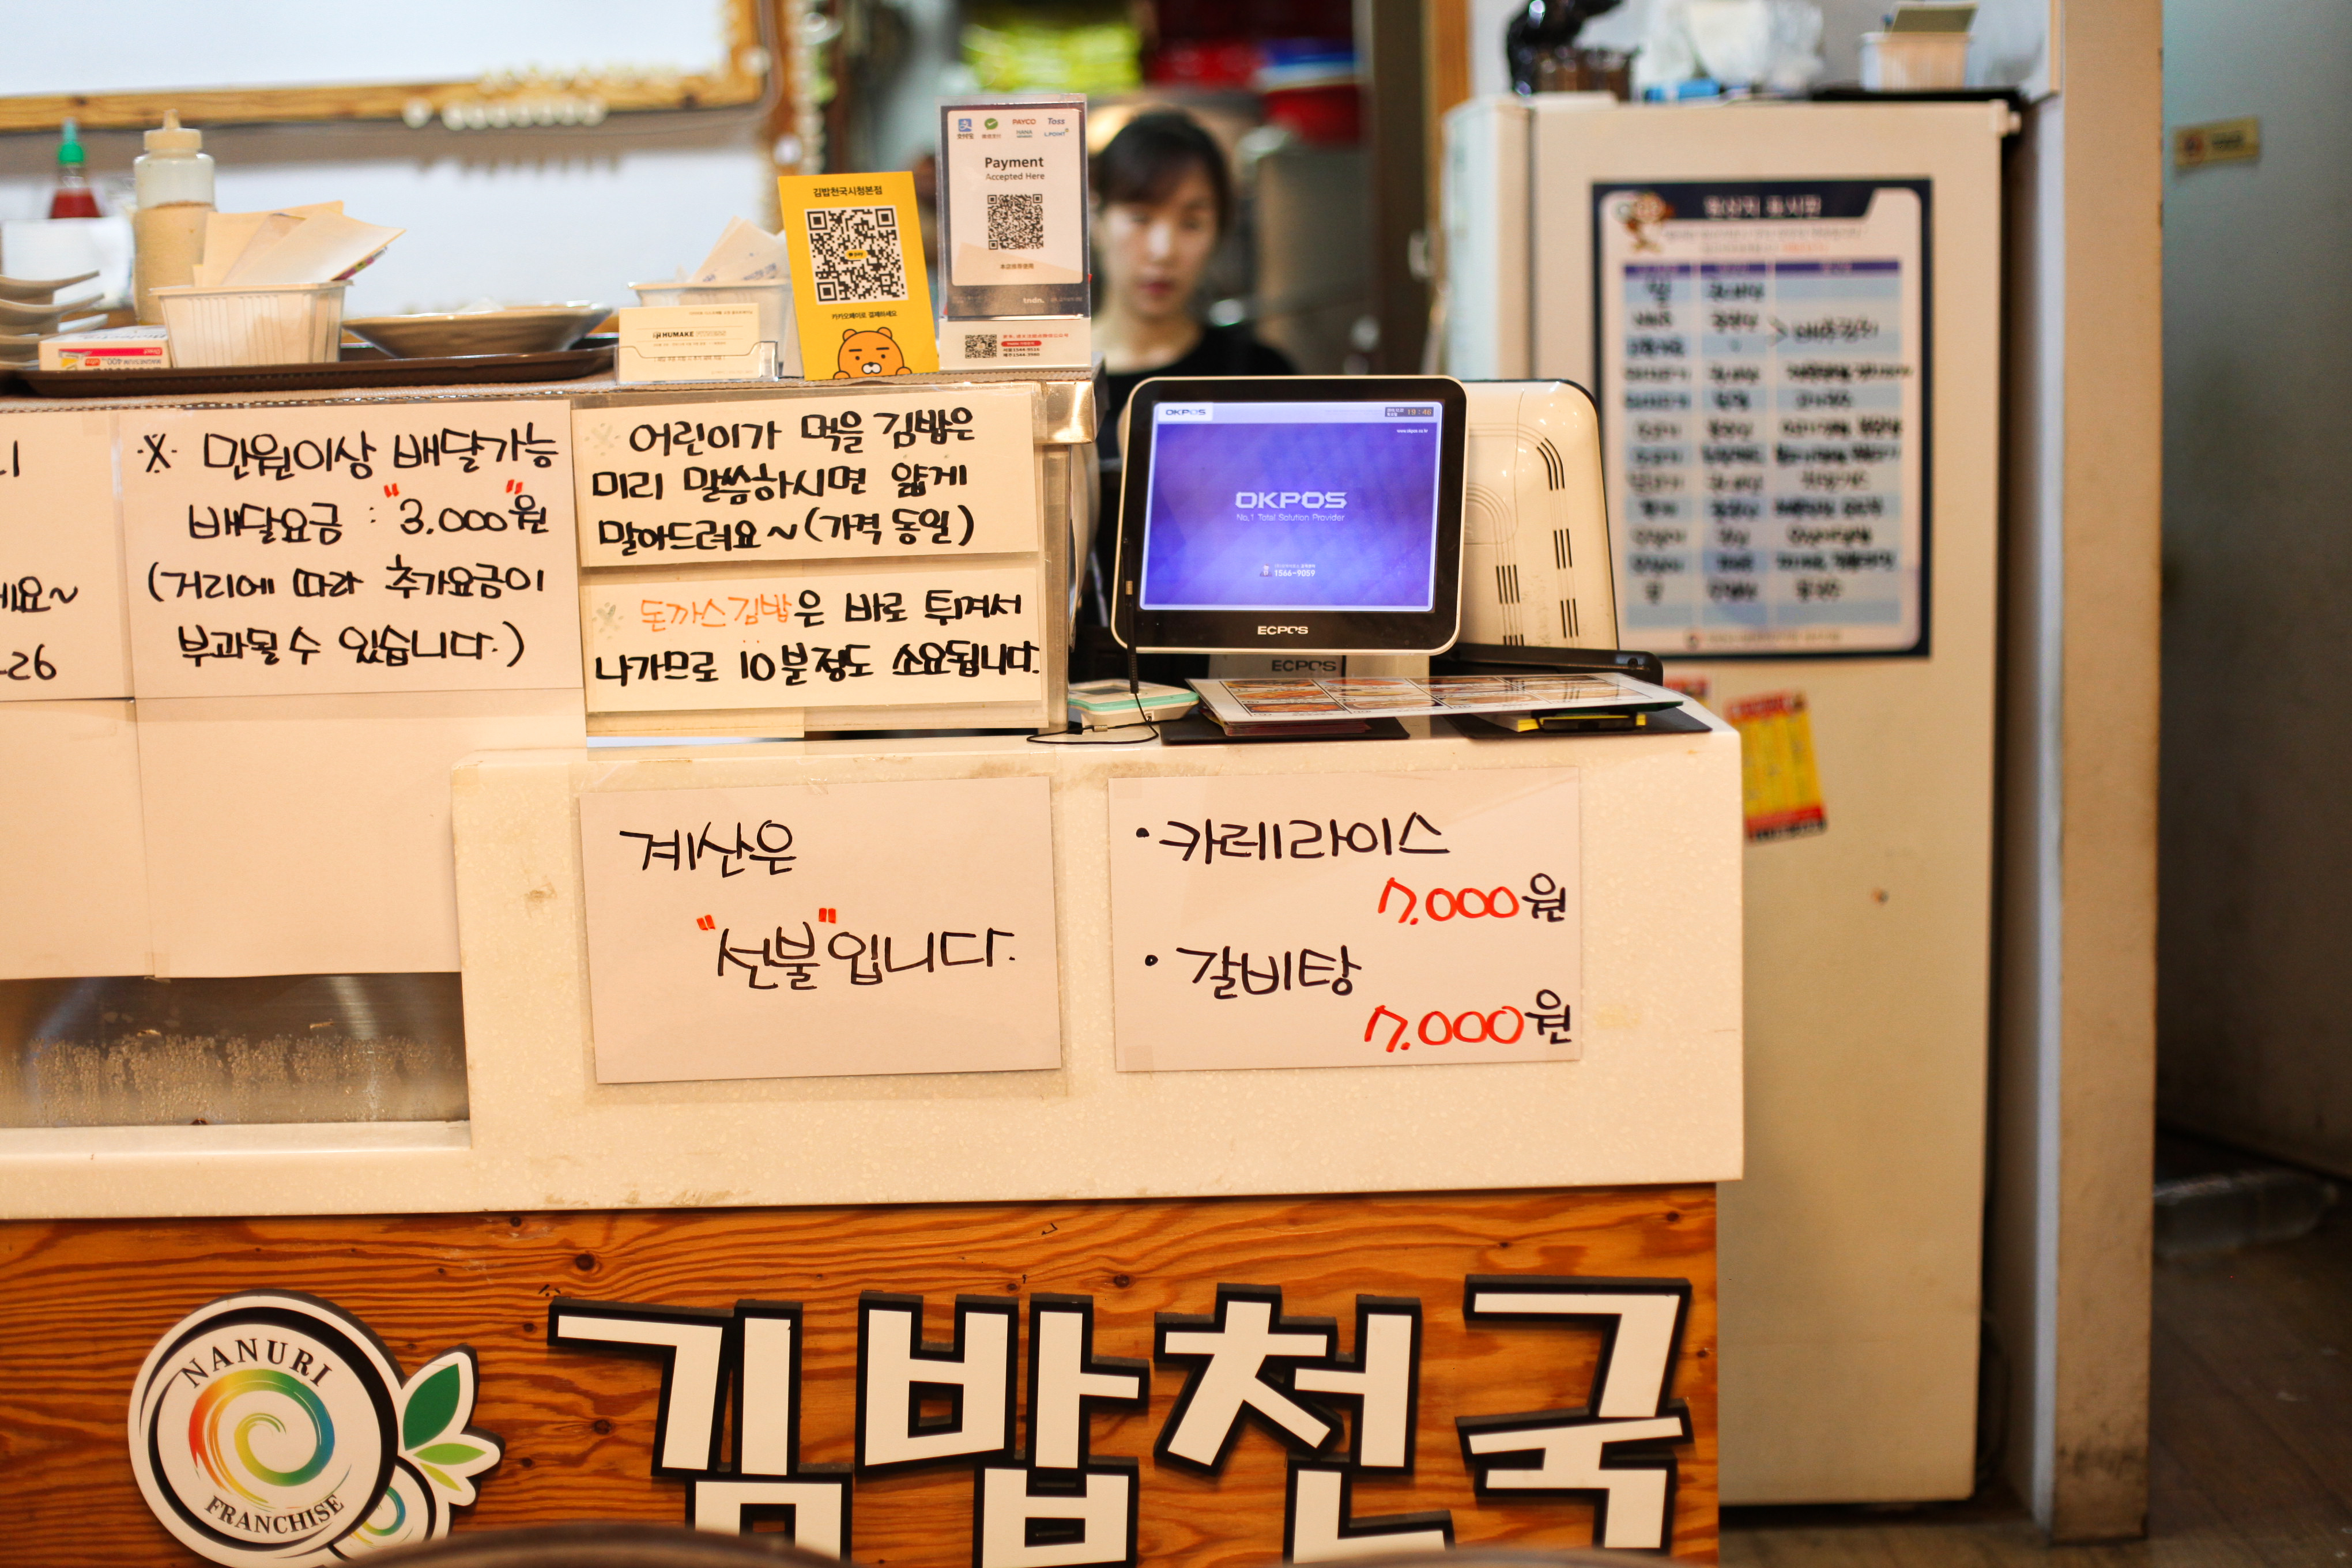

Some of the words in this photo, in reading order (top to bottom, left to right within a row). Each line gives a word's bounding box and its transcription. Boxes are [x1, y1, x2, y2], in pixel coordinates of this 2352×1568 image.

[985, 157, 1044, 170] Payment
[986, 173, 1023, 182] Accepted
[813, 186, 883, 197] 김밥천국시청본점
[630, 421, 782, 456] 어린이가
[801, 411, 864, 454] 먹을
[873, 408, 974, 449] 김밥은
[1166, 408, 1207, 416] OKPOS
[204, 431, 376, 481] 만원이상
[394, 422, 559, 473] 배달가능
[593, 472, 663, 500] 미리
[684, 463, 866, 505] 말씀하시면
[892, 463, 967, 498] 얇게
[1235, 492, 1348, 508] OKPOS
[189, 502, 342, 545] 배달요금
[892, 505, 974, 546] 동일)
[149, 562, 274, 602] (거리에
[293, 568, 364, 597] 따라
[385, 554, 544, 599] 추가요금이
[640, 589, 824, 632] 돈까스김밥은
[845, 593, 907, 622] 바로
[925, 590, 1021, 625] 튀겨서
[1257, 625, 1309, 635] ECPOS
[339, 621, 524, 667] 있습니다.)
[1271, 659, 1337, 672] ECPOS
[595, 651, 718, 687] 나가므로
[620, 820, 797, 878] 계산은
[1159, 812, 1450, 864] 카레라이스
[1378, 873, 1565, 925] 7.000원
[1176, 945, 1362, 1000] 갈비탕
[1365, 989, 1571, 1053] 7.000원
[180, 1338, 333, 1388] NANURI
[549, 1277, 1693, 1567] 김밥천국
[204, 1494, 345, 1535] FRANCHISE
